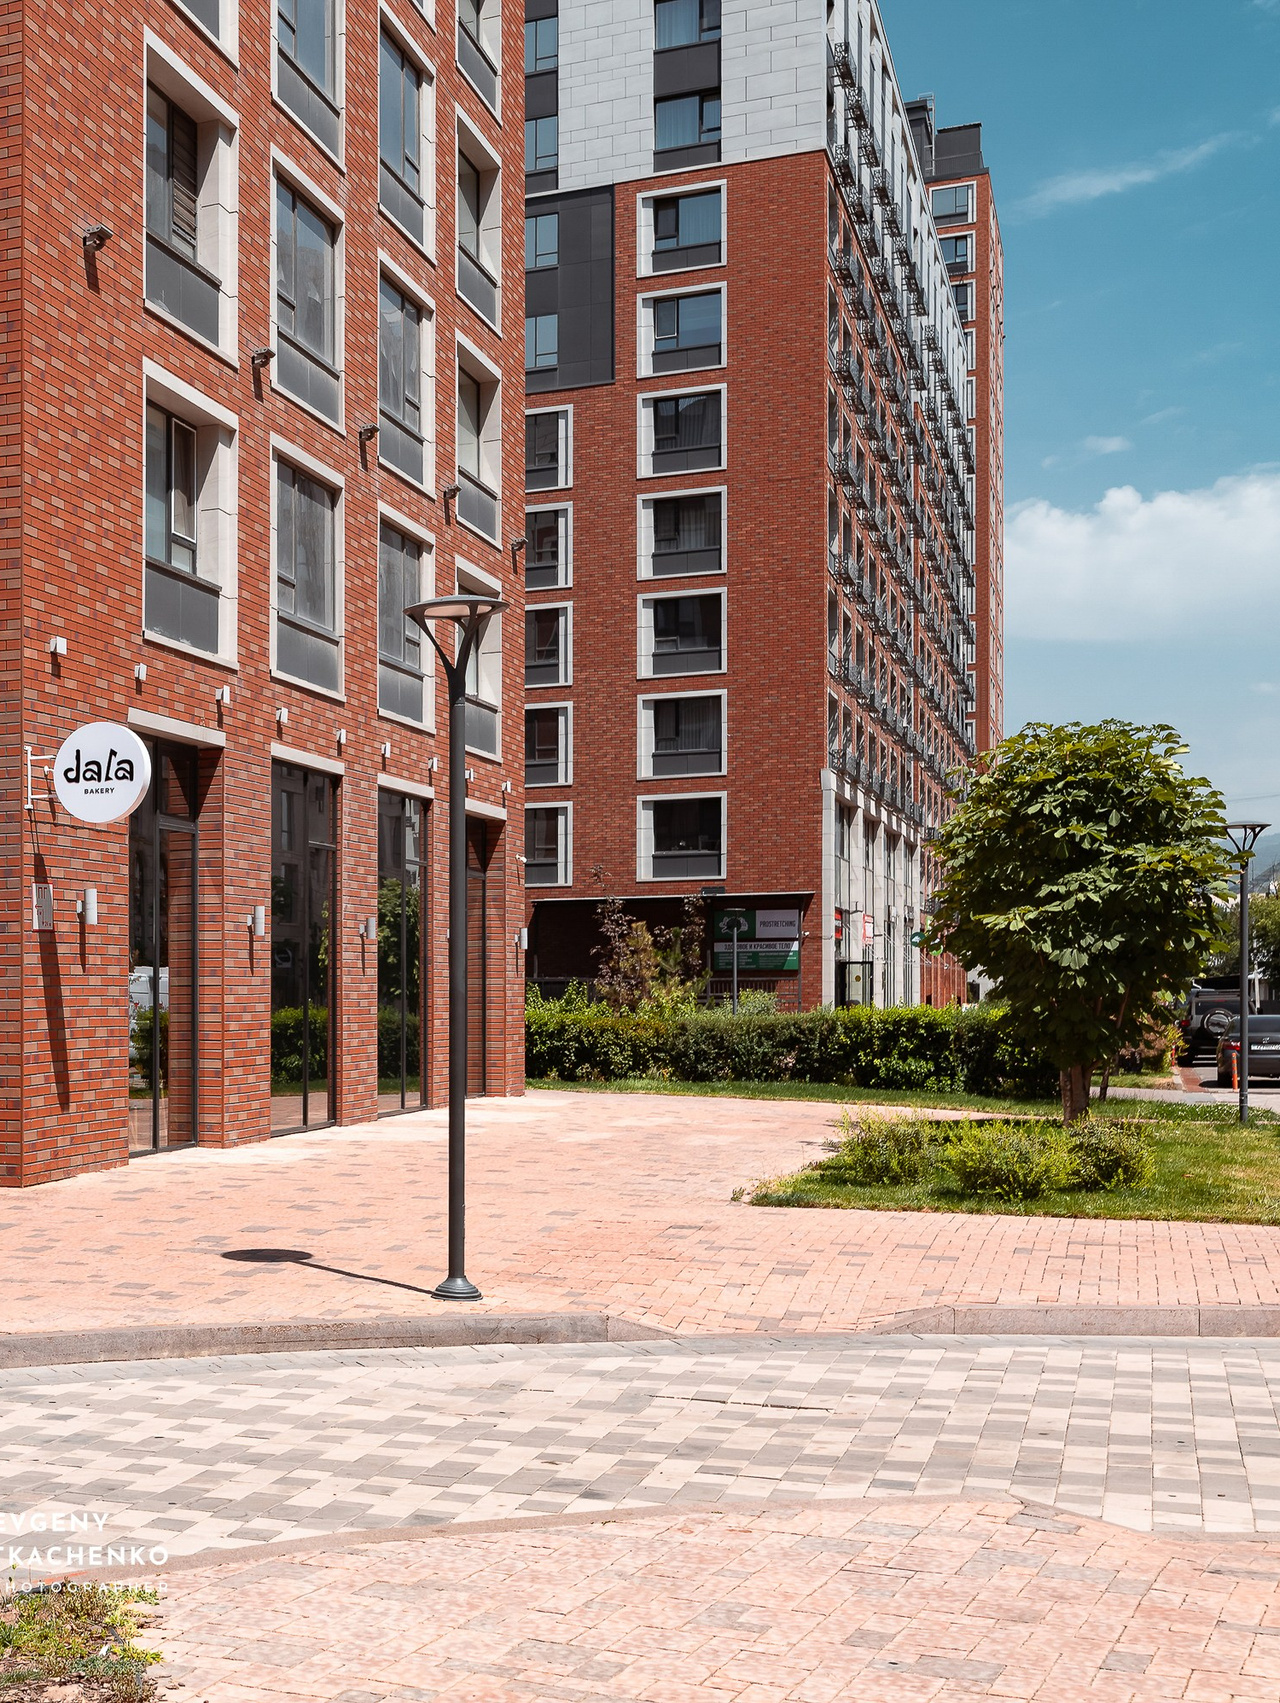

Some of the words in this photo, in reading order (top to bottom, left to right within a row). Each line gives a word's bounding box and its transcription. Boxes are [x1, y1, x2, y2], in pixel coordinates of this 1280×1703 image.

[63, 748, 134, 783] dala
[84, 787, 115, 795] BAKERY
[759, 920, 796, 928] PROSTRETCHING
[724, 943, 748, 951] ЗДООВОЕ
